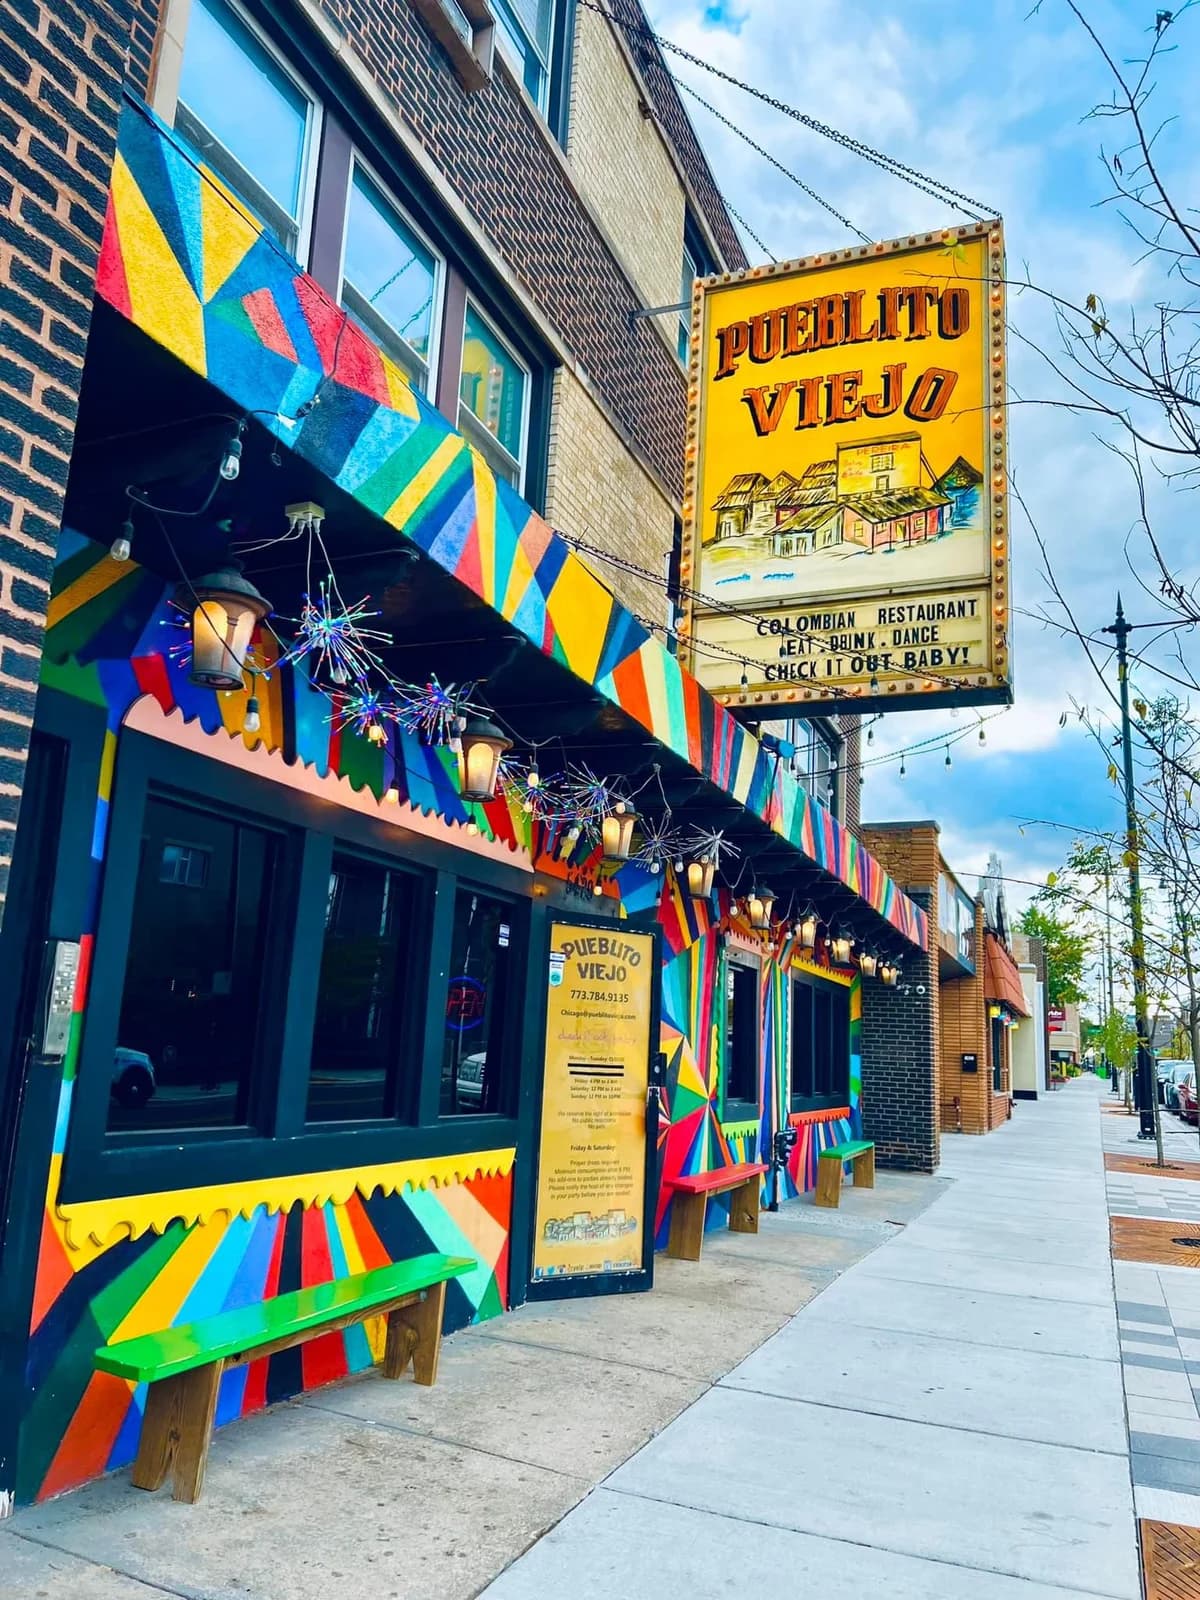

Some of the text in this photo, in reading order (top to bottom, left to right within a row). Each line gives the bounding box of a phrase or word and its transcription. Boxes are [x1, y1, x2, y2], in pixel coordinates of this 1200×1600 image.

[714, 286, 970, 381] PUEBLITO
[741, 363, 959, 436] VIEJO
[757, 599, 977, 636] COLOMBIAN RESTAURANT
[893, 626, 939, 646] DANCE
[764, 647, 970, 681] CHECK IT OUT BABY!
[561, 937, 640, 967] PUEBLITO
[577, 962, 626, 982] VIEJO
[570, 990, 629, 1003] 773.784.9135
